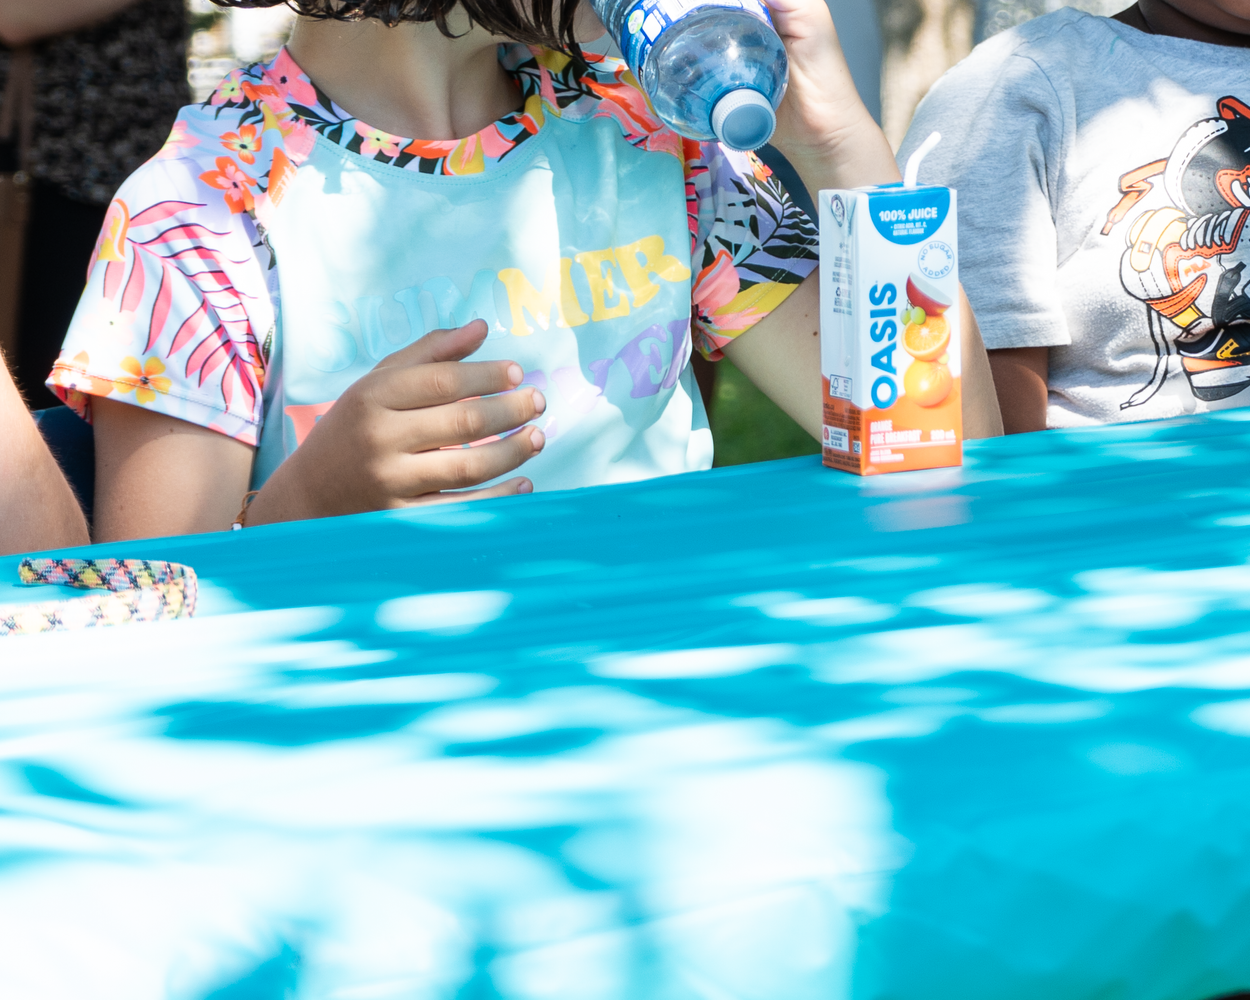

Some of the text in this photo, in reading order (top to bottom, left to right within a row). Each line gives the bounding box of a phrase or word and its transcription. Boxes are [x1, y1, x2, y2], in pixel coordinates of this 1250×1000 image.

[879, 207, 938, 222] 100% JUICE
[921, 243, 952, 261] NO SUGAR
[923, 265, 949, 277] ADDED
[1183, 260, 1212, 277] FILA
[869, 282, 898, 410] OASIS
